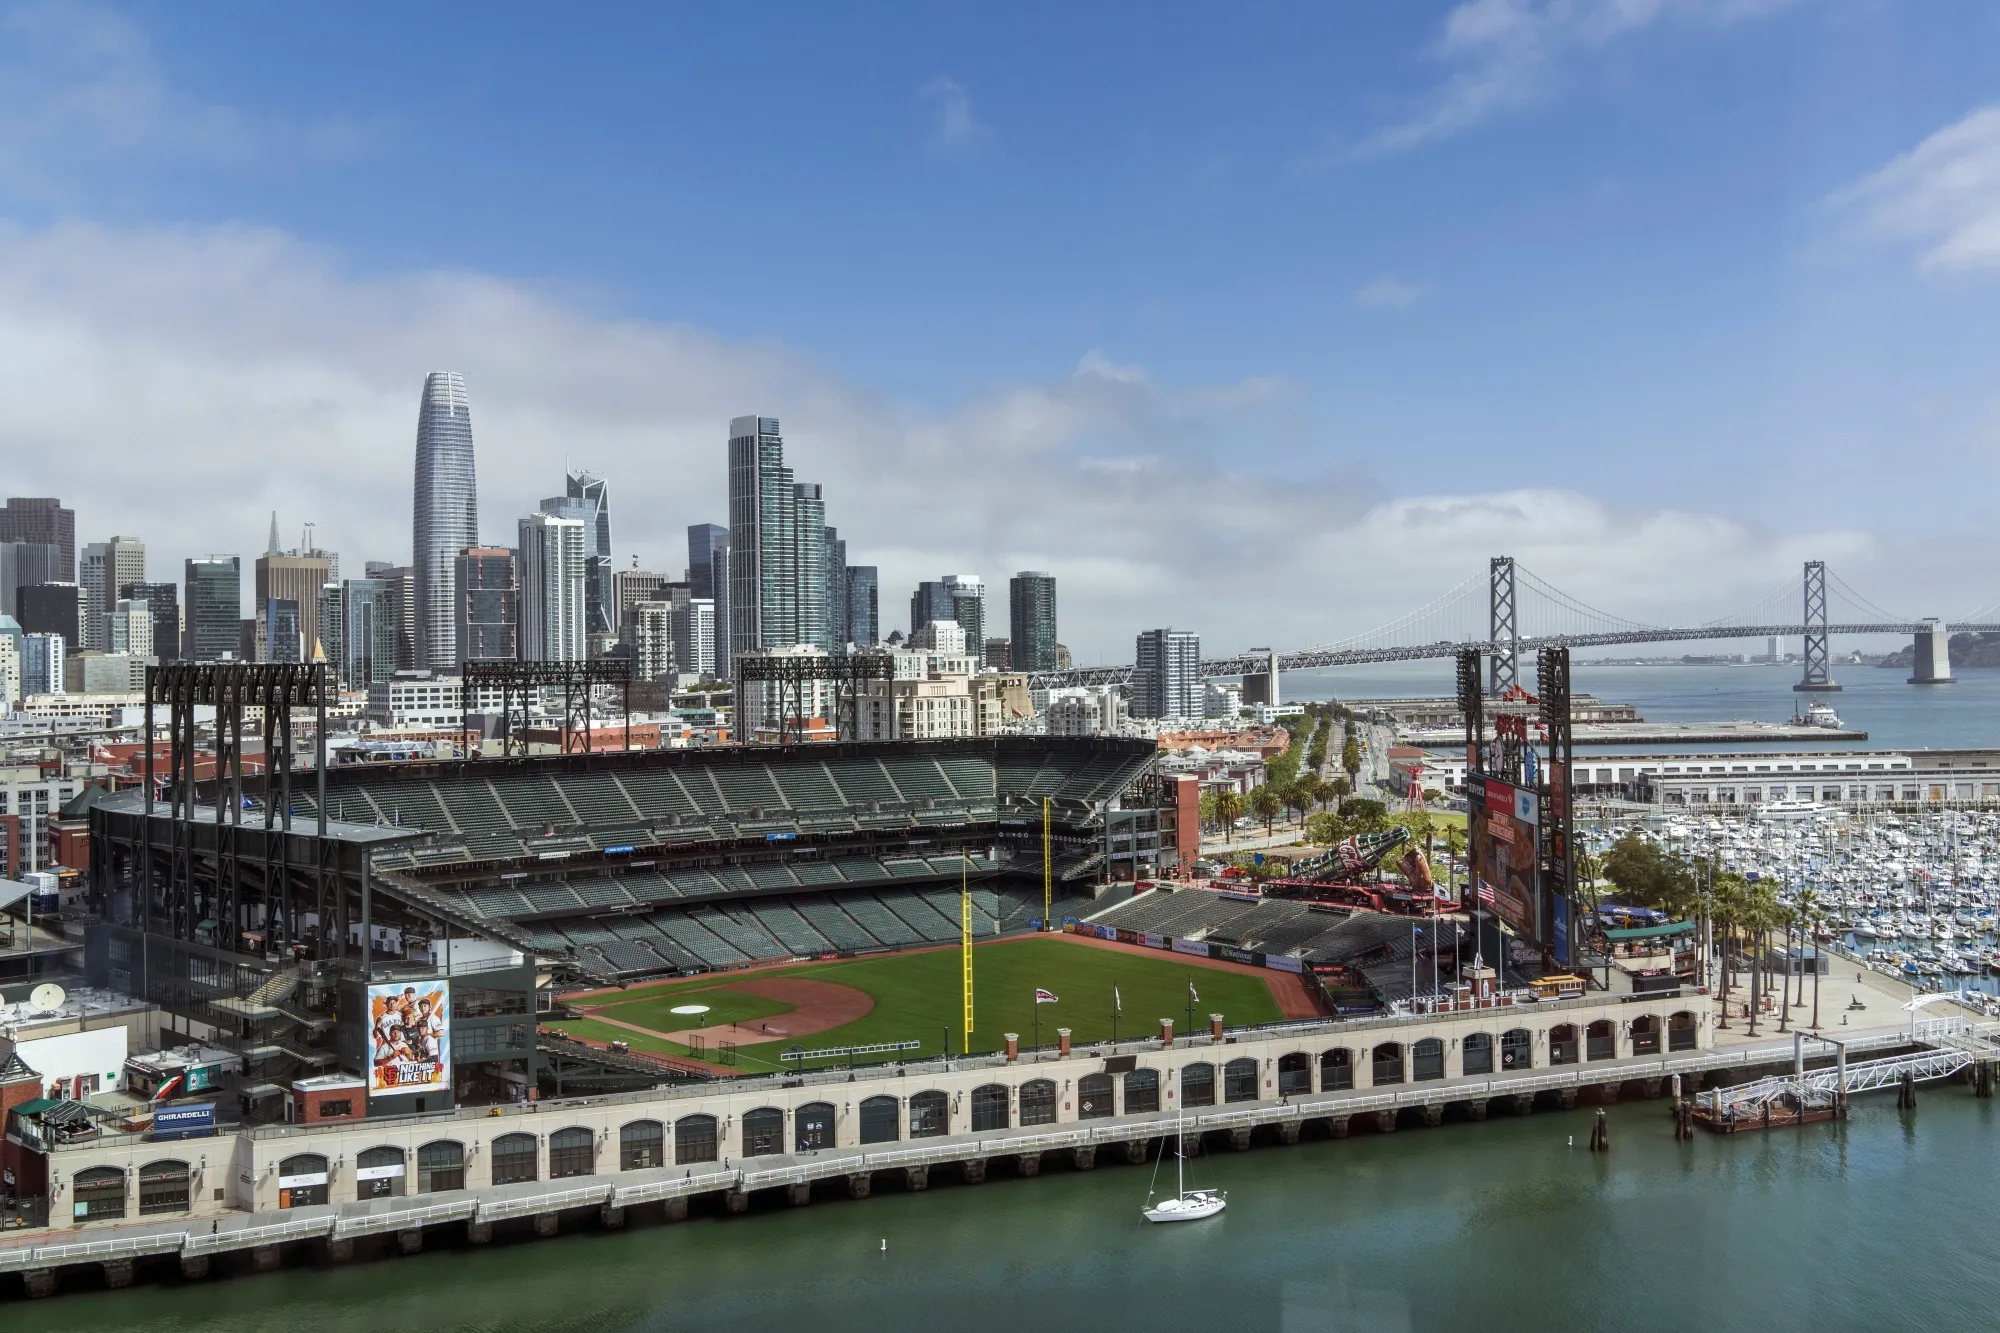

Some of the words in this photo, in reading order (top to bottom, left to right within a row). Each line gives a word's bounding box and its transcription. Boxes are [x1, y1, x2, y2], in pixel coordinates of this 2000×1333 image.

[1228, 949, 1252, 961] National
[400, 1062, 436, 1073] NOTHING
[399, 1072, 420, 1083] LIKE
[422, 1070, 434, 1081] IT
[158, 1111, 210, 1121] GHIRARDELLI
